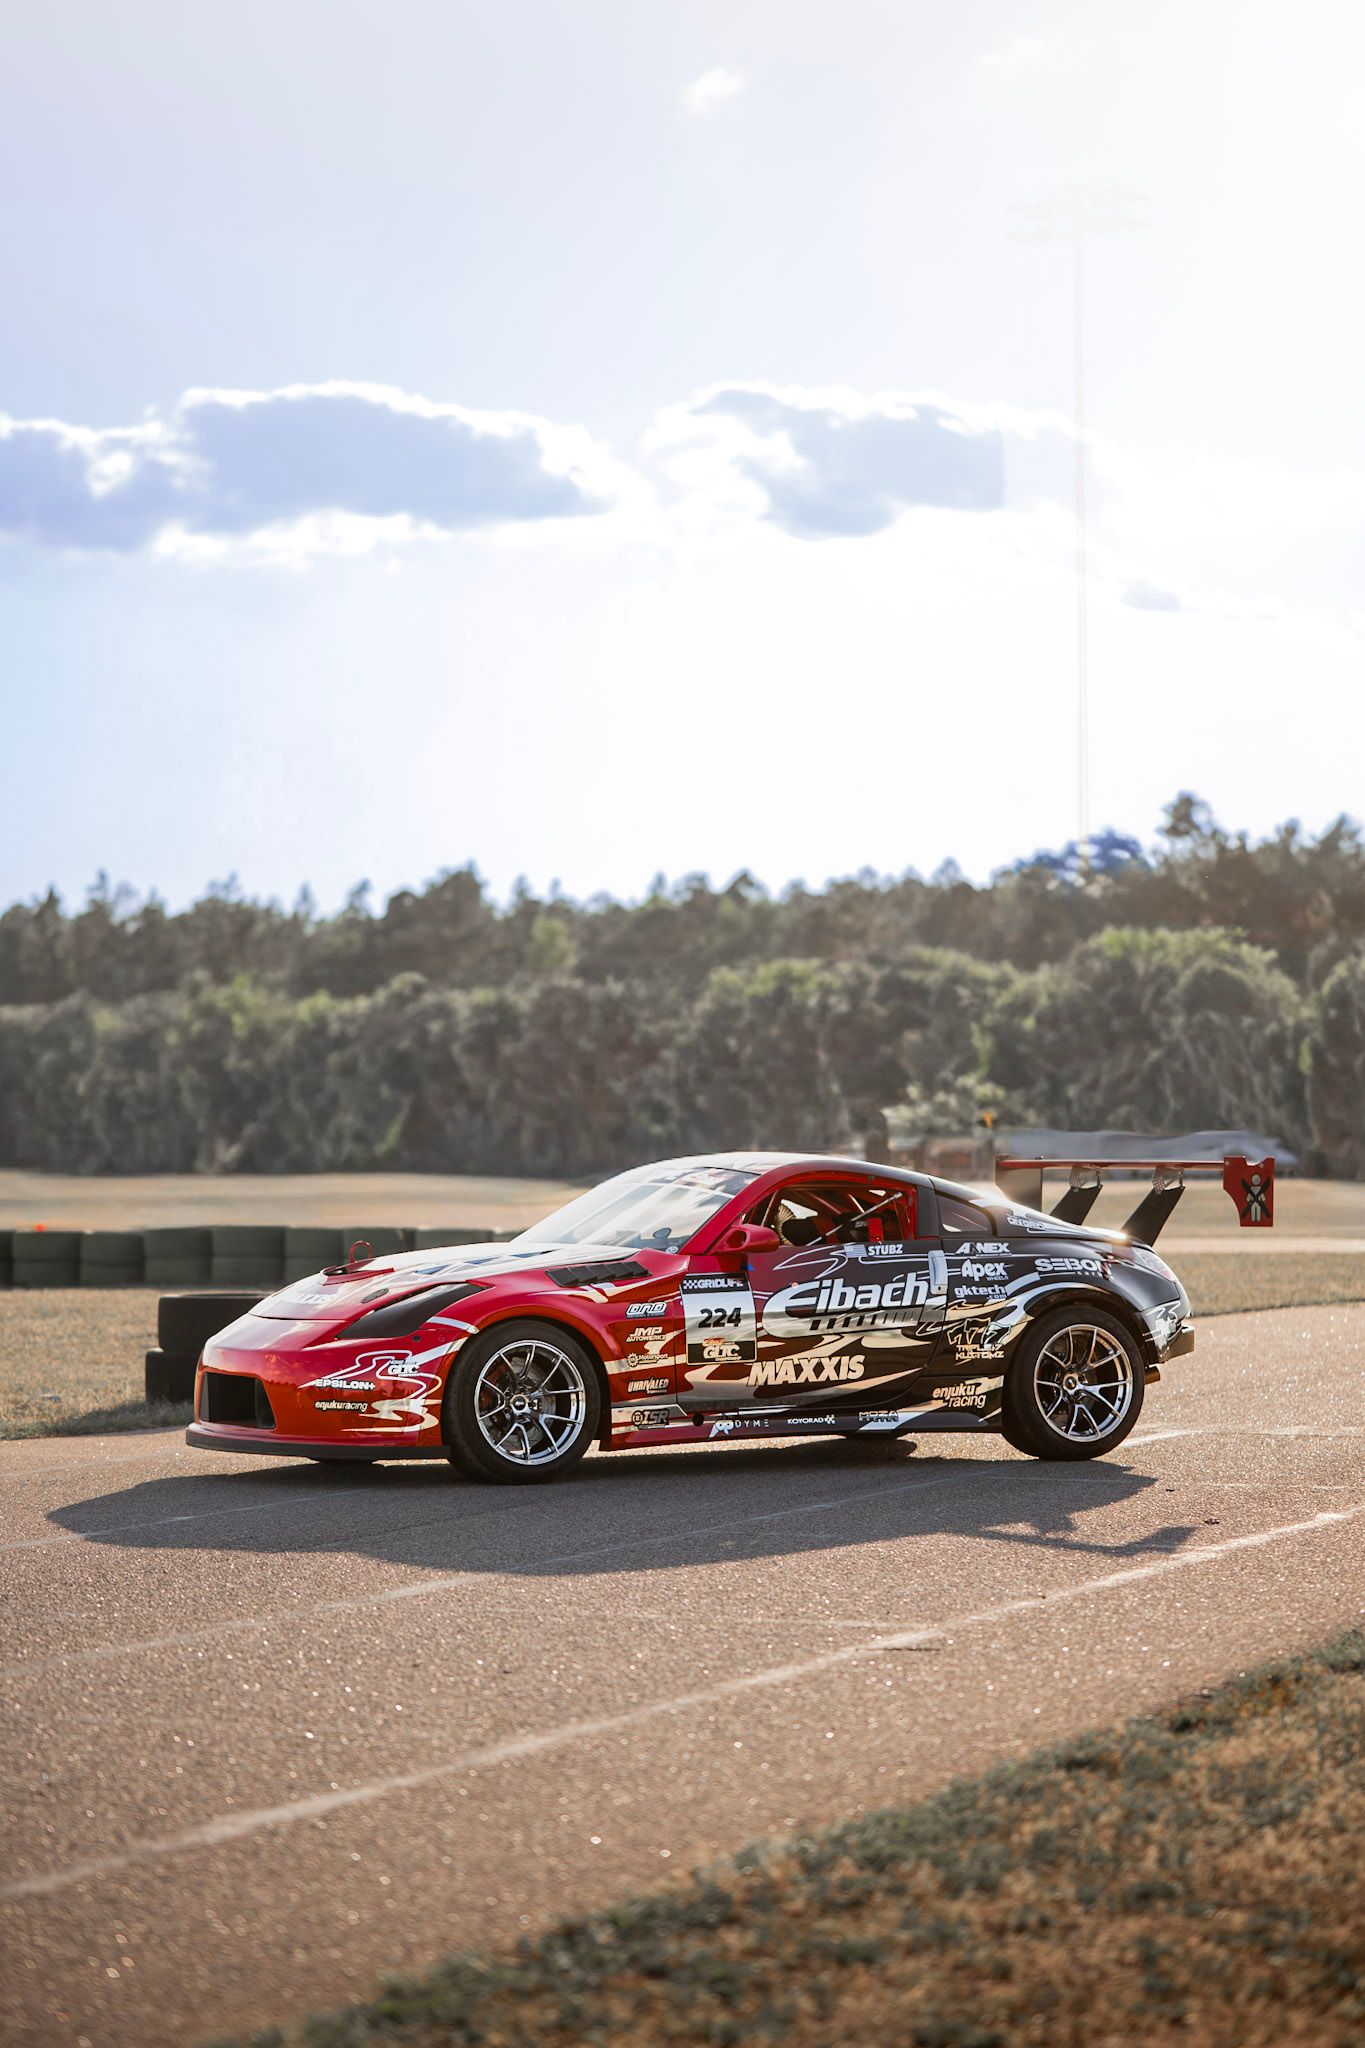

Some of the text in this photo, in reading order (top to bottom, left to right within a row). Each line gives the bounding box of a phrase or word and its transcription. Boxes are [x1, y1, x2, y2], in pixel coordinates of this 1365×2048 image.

[868, 1244, 903, 1256] STUBZ
[961, 1259, 1007, 1282] Apex
[697, 1279, 744, 1288] GRIDLIFE
[954, 1285, 1006, 1298] gktech
[762, 1273, 930, 1338] Eibach
[698, 1307, 741, 1328] 224
[629, 1326, 663, 1337] JMP
[955, 1351, 1005, 1360] KUSTOMZ
[746, 1355, 865, 1386] MAXXIS
[627, 1377, 669, 1394] UNRIVALED
[932, 1383, 976, 1400] enjuku
[948, 1395, 987, 1408] racing
[641, 1410, 669, 1424] ISR
[735, 1419, 769, 1428] DYME
